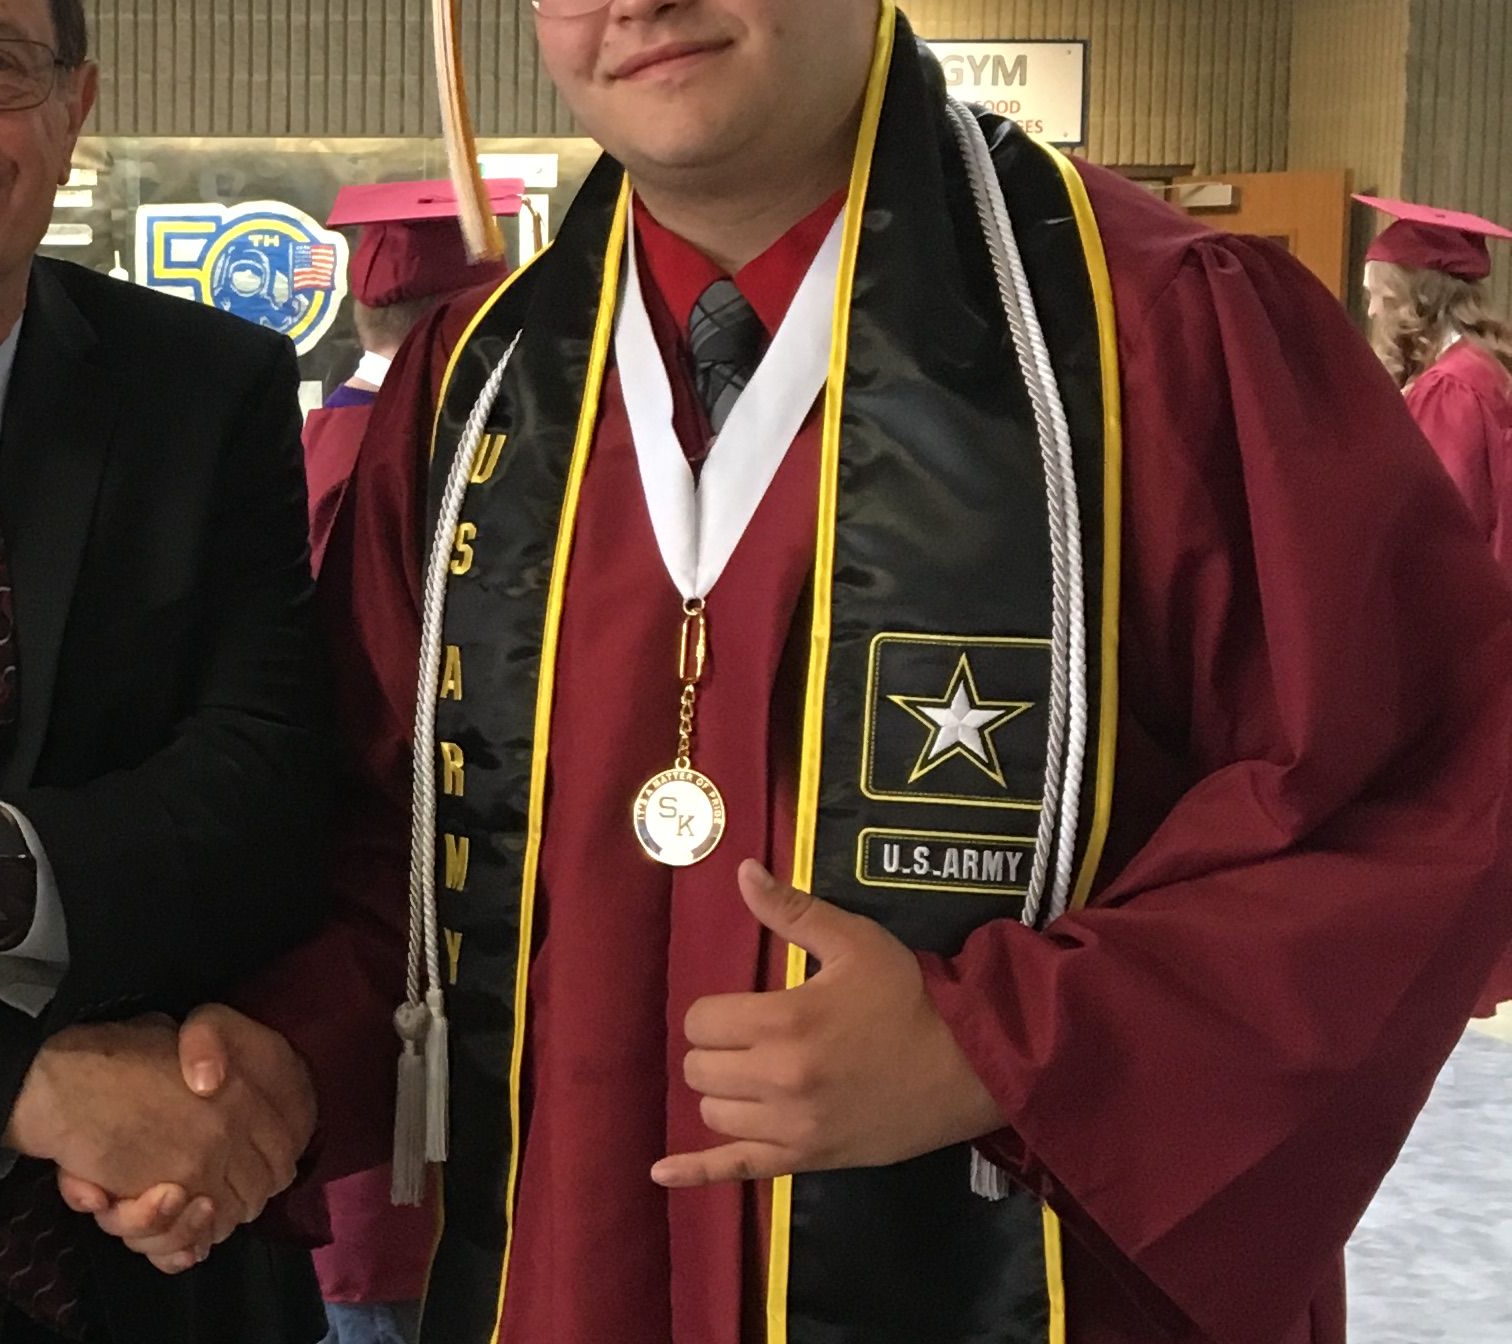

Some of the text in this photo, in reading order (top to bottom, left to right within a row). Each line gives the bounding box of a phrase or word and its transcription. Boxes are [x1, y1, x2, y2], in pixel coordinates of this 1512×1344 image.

[941, 54, 1029, 87] GYM
[975, 99, 1021, 115] OOD
[248, 234, 280, 247] TH
[439, 645, 469, 985] ARMY
